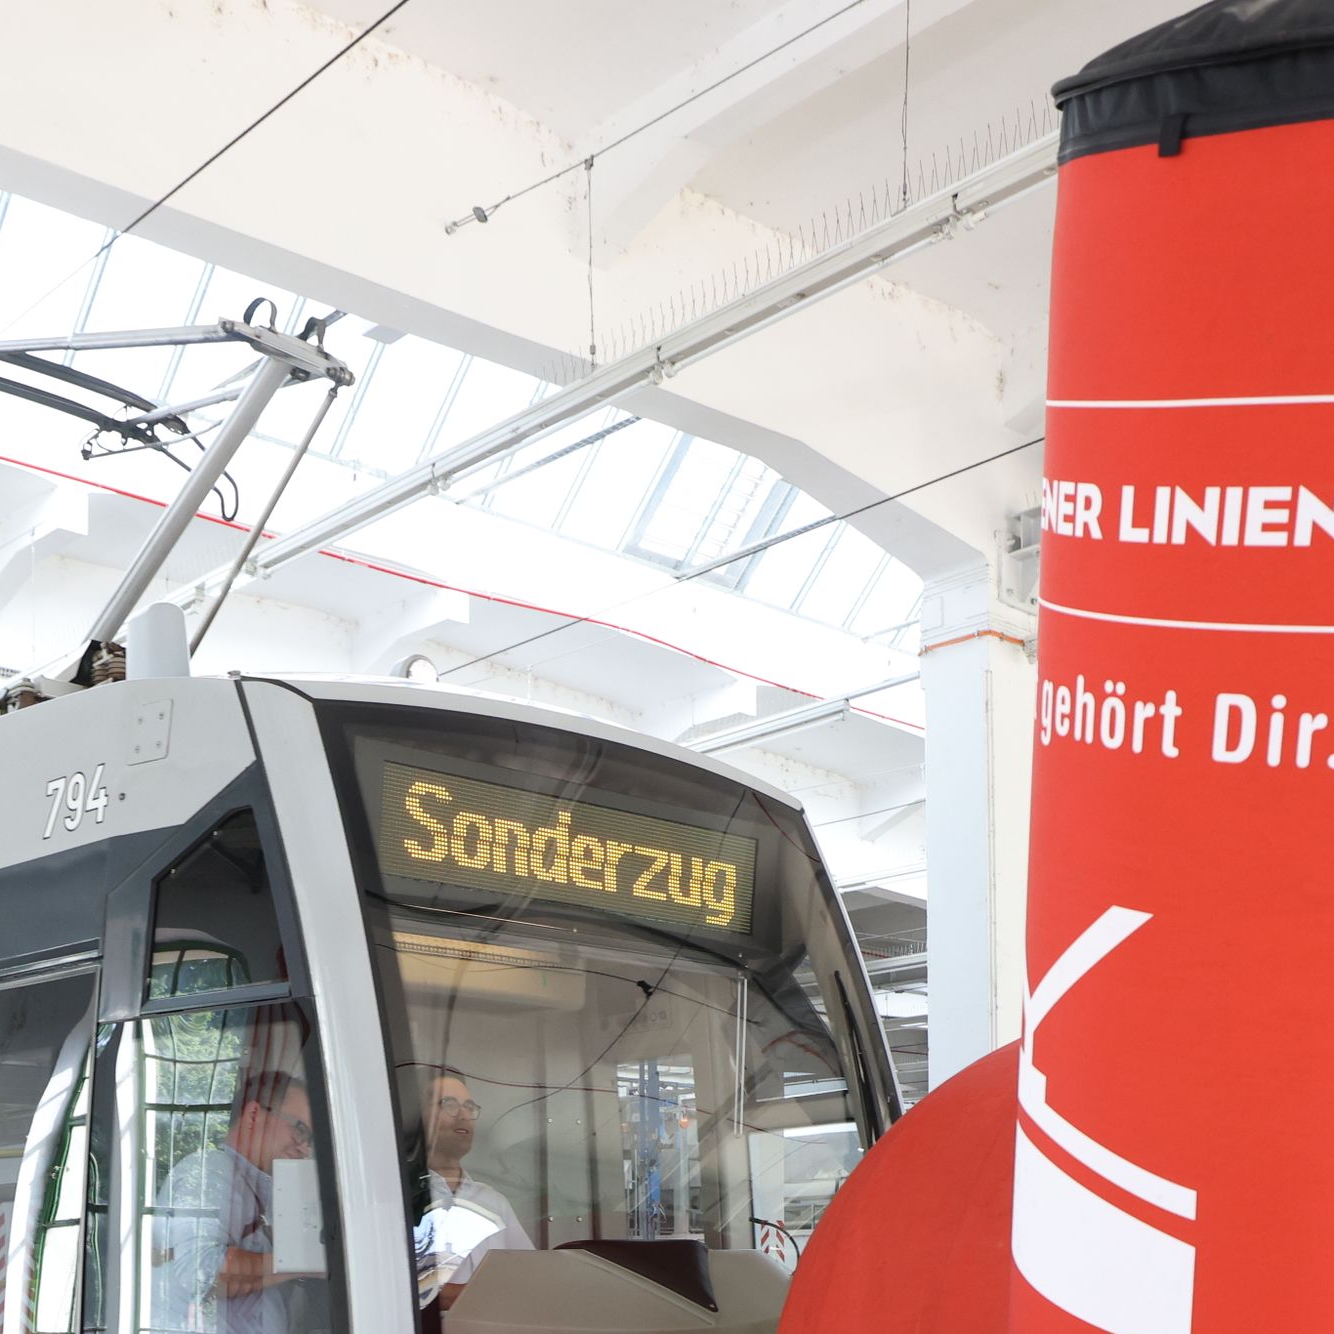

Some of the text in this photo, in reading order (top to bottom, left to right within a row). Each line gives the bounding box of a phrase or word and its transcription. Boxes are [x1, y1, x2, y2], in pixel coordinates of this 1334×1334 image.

[1040, 673, 1183, 758] gehört
[40, 763, 110, 841] 794
[403, 780, 738, 928] Sonderzug
